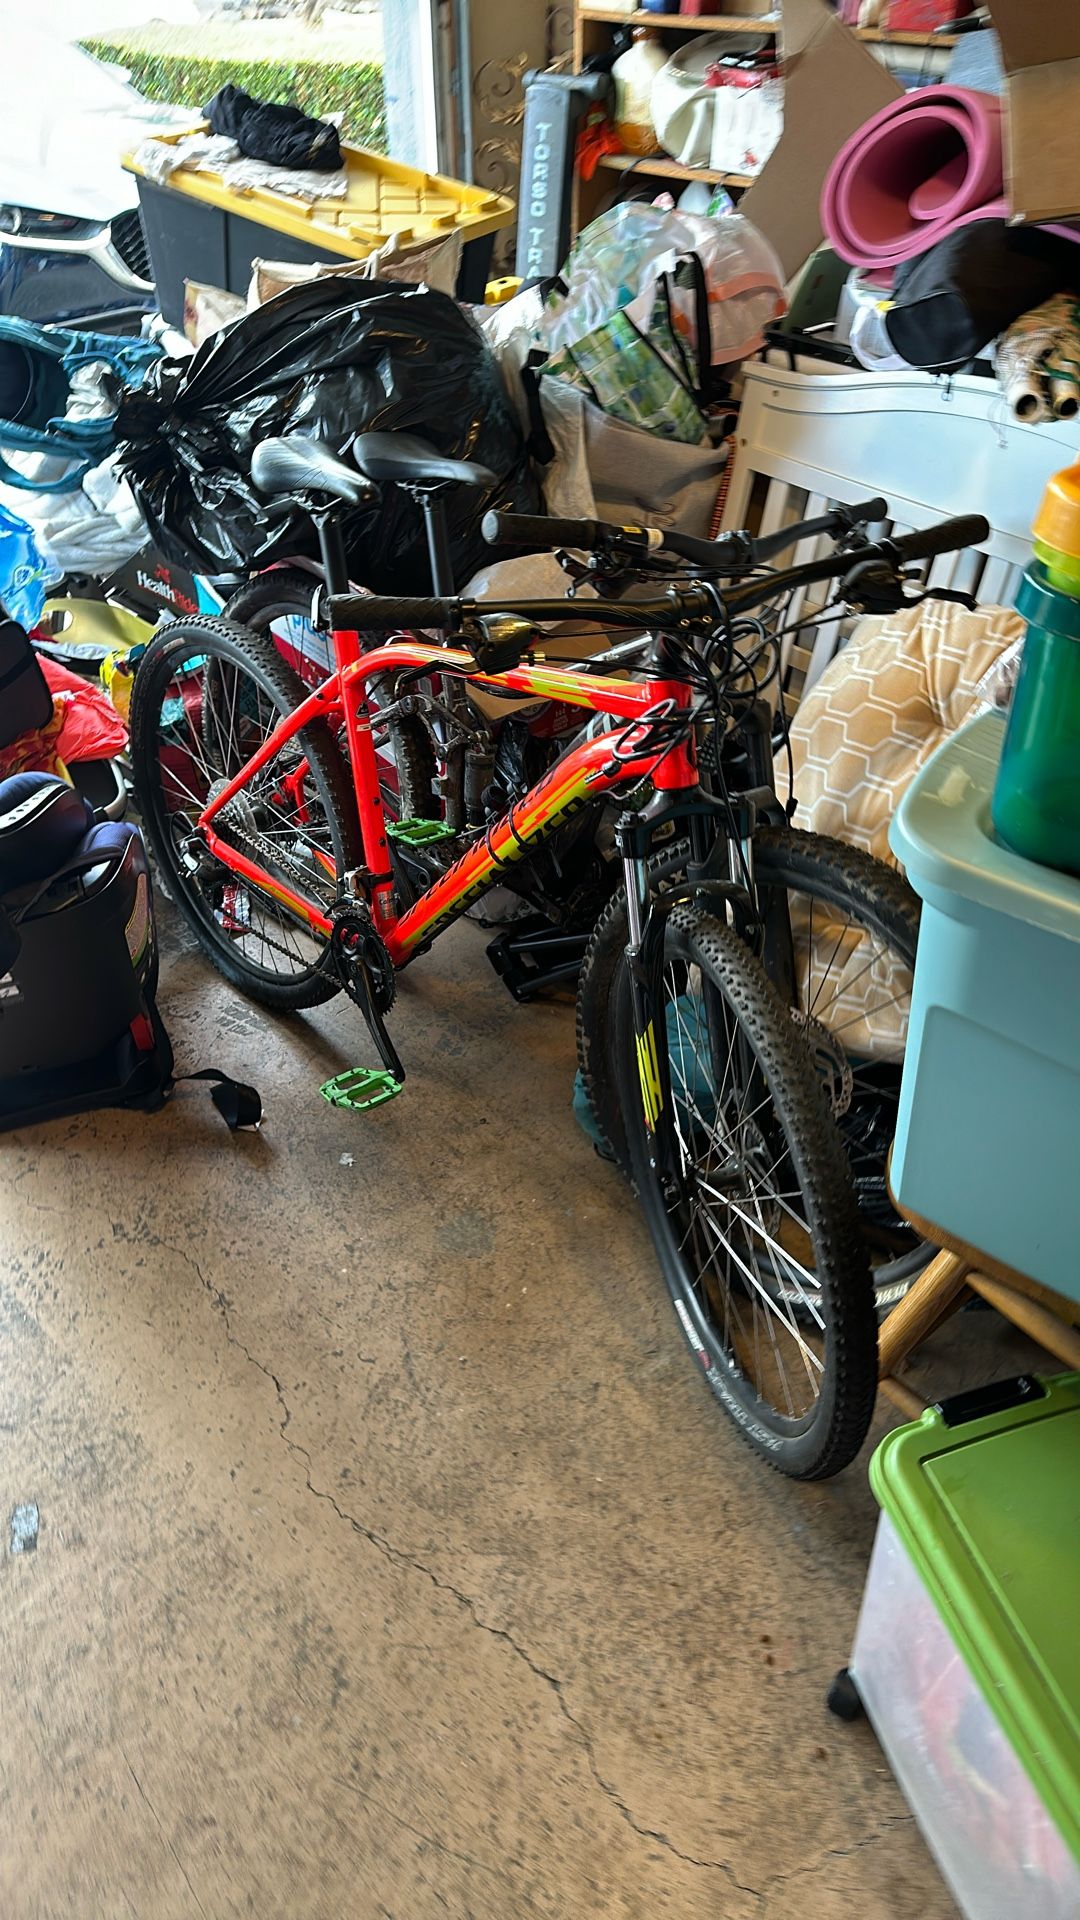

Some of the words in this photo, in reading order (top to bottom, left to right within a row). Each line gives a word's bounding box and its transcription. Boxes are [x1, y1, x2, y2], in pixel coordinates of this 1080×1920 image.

[530, 122, 552, 218] TORSO
[526, 226, 545, 280] TRA
[136, 569, 199, 615] HealthRide
